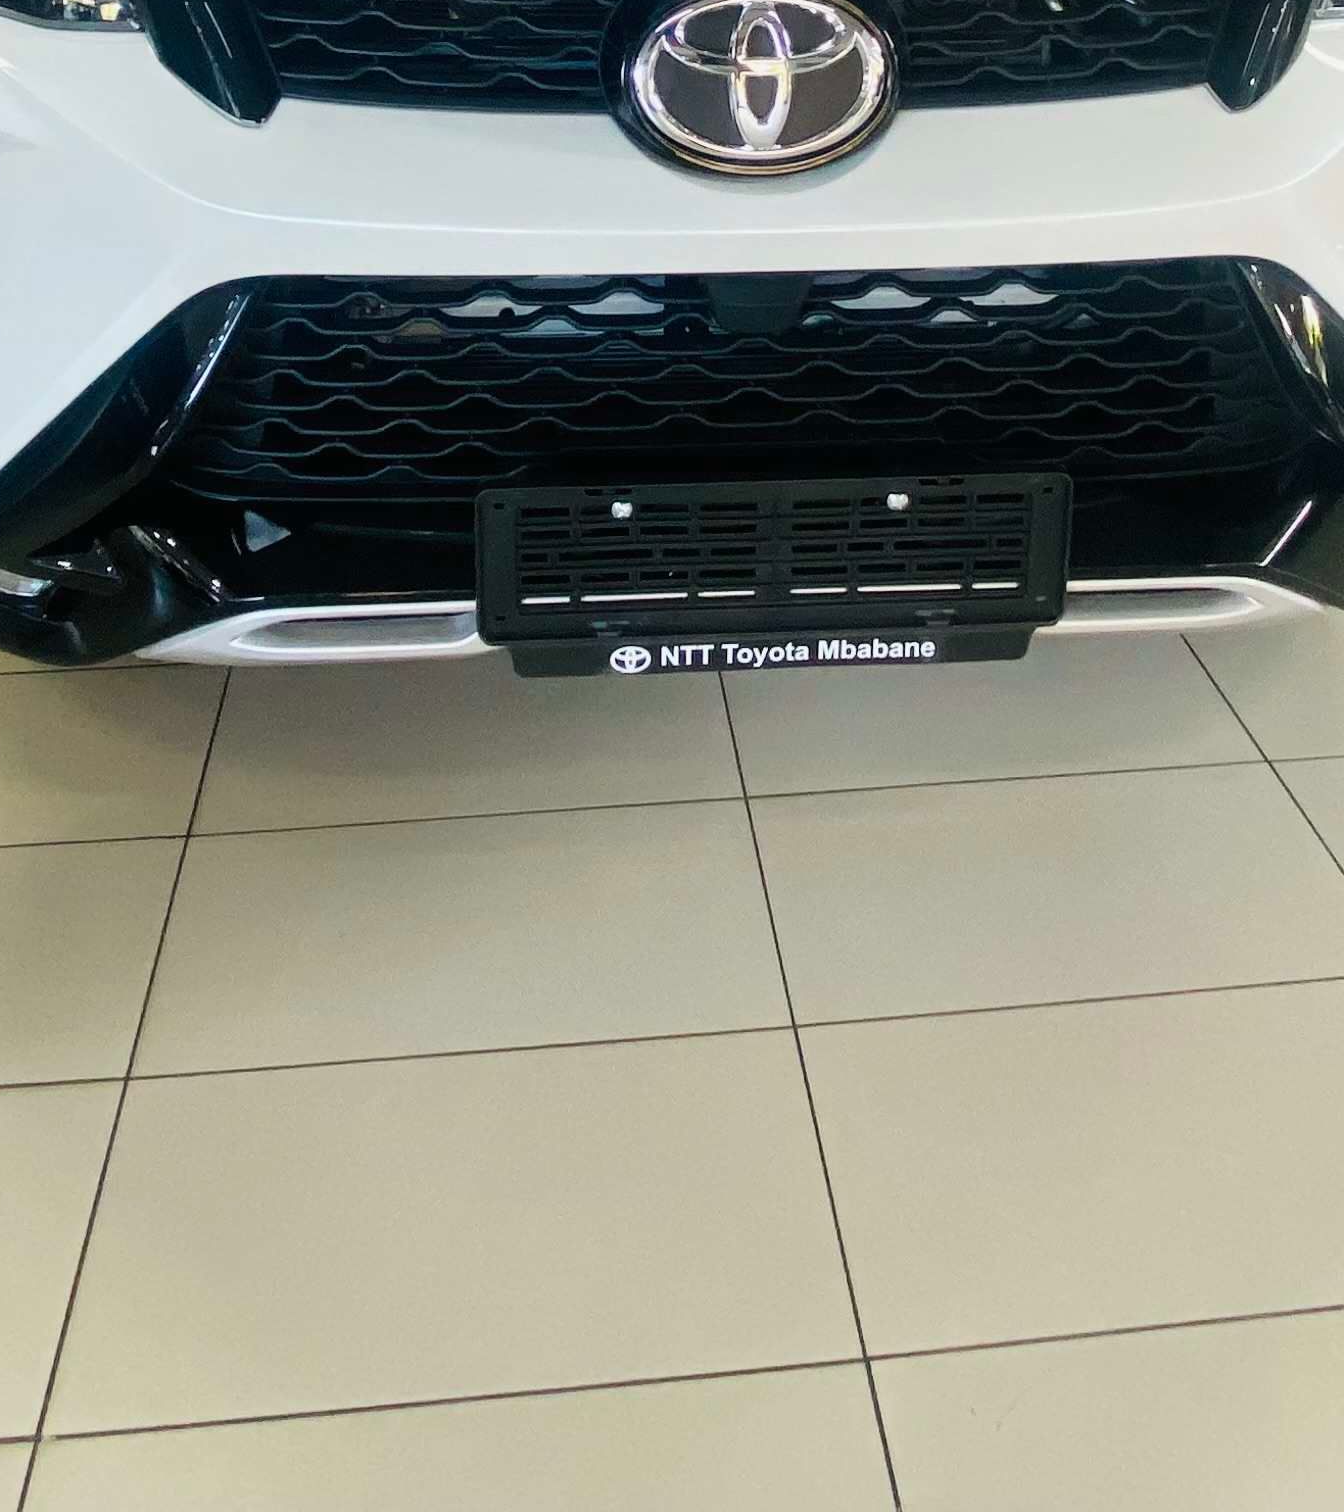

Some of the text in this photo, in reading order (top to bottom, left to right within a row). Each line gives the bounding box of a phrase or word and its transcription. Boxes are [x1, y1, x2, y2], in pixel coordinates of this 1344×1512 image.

[660, 638, 936, 668] NTT Toyota Mbabane
